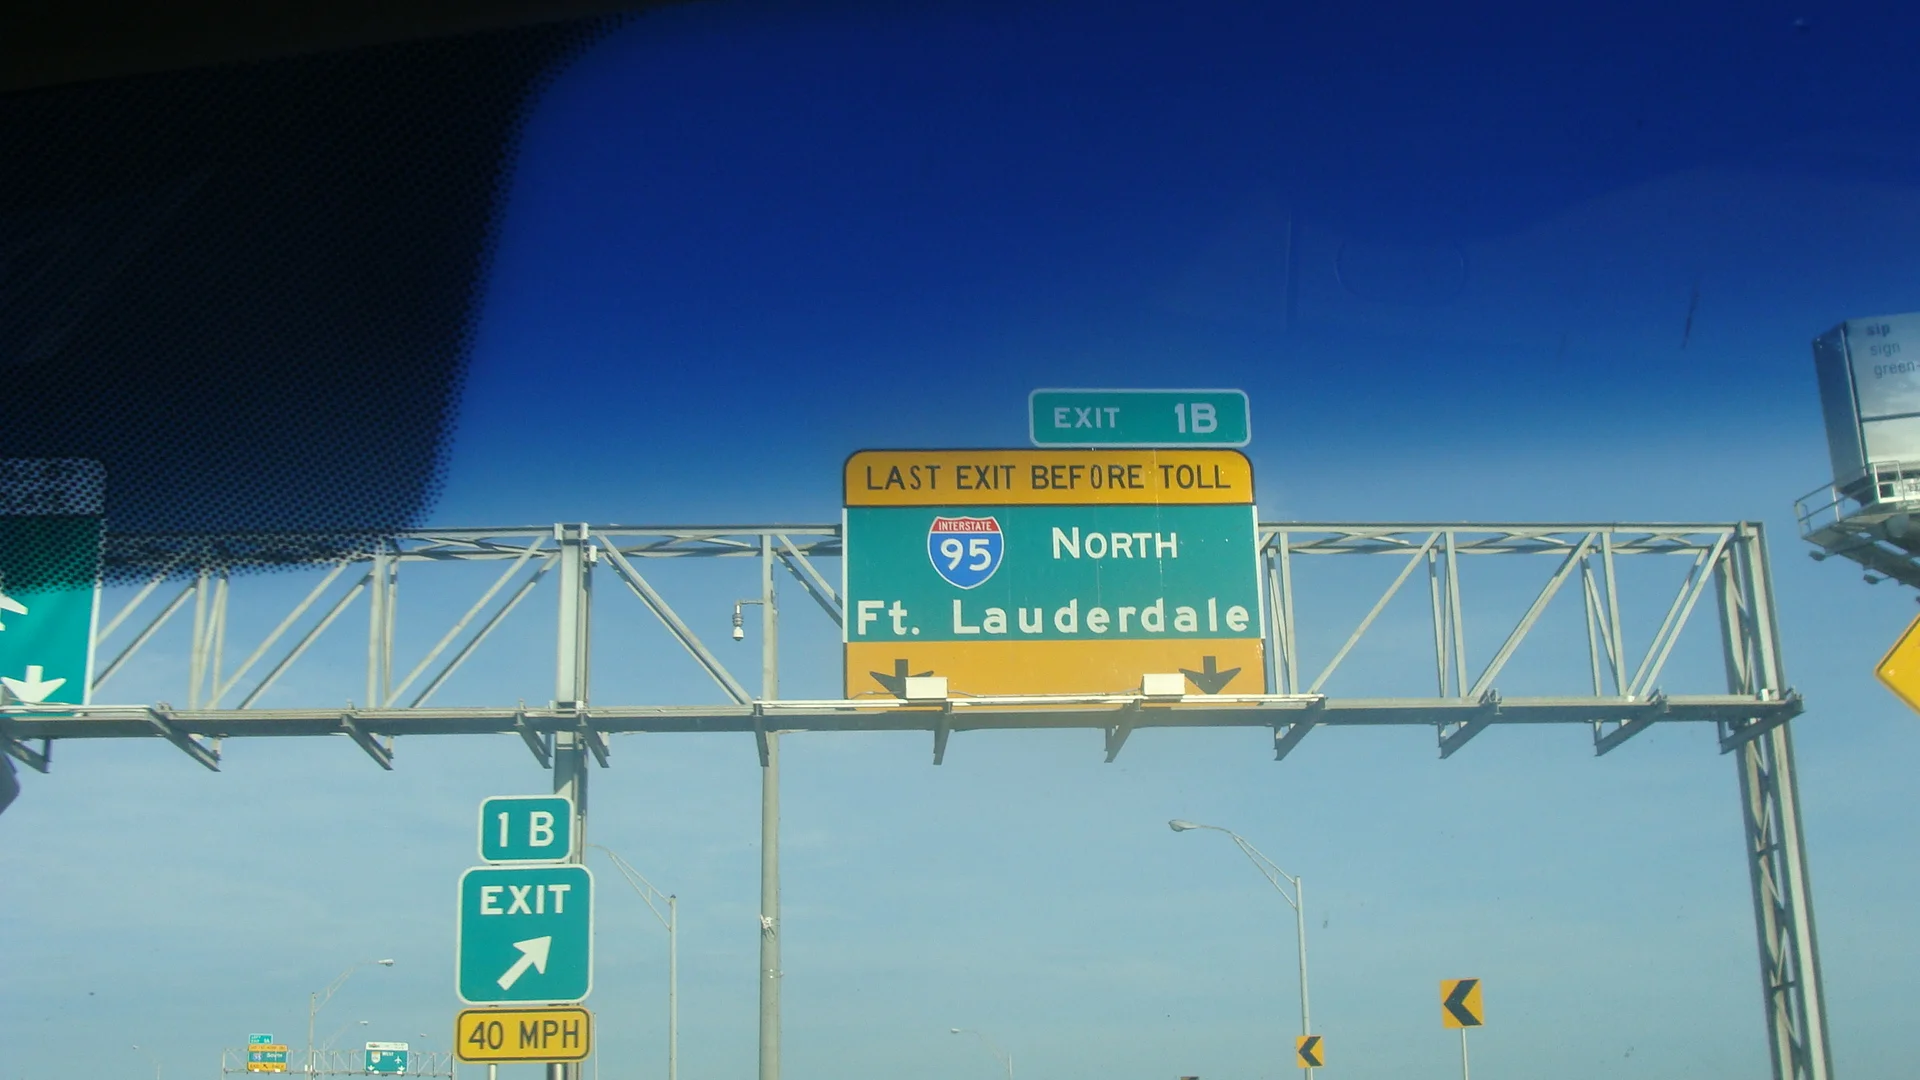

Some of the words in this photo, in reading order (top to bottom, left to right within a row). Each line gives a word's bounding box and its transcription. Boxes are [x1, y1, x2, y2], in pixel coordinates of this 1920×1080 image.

[1866, 322, 1890, 337] sip
[1870, 342, 1900, 357] sign
[1053, 406, 1120, 429] EXIT
[1174, 402, 1219, 434] 1B
[866, 464, 942, 491] LAST
[956, 464, 1017, 490] EXIT
[1031, 464, 1144, 490] BEFORE
[1162, 464, 1232, 489] TOLL
[938, 519, 993, 532] INTERSTATE
[940, 537, 991, 572] 95
[1051, 526, 1178, 560] NORTH
[857, 599, 920, 636] Ft.
[953, 596, 1250, 635] Lauderdale
[498, 811, 510, 848] 1
[529, 810, 555, 847] B
[480, 884, 571, 915] EXIT
[468, 1020, 504, 1050] 40
[519, 1019, 579, 1050] MPH
